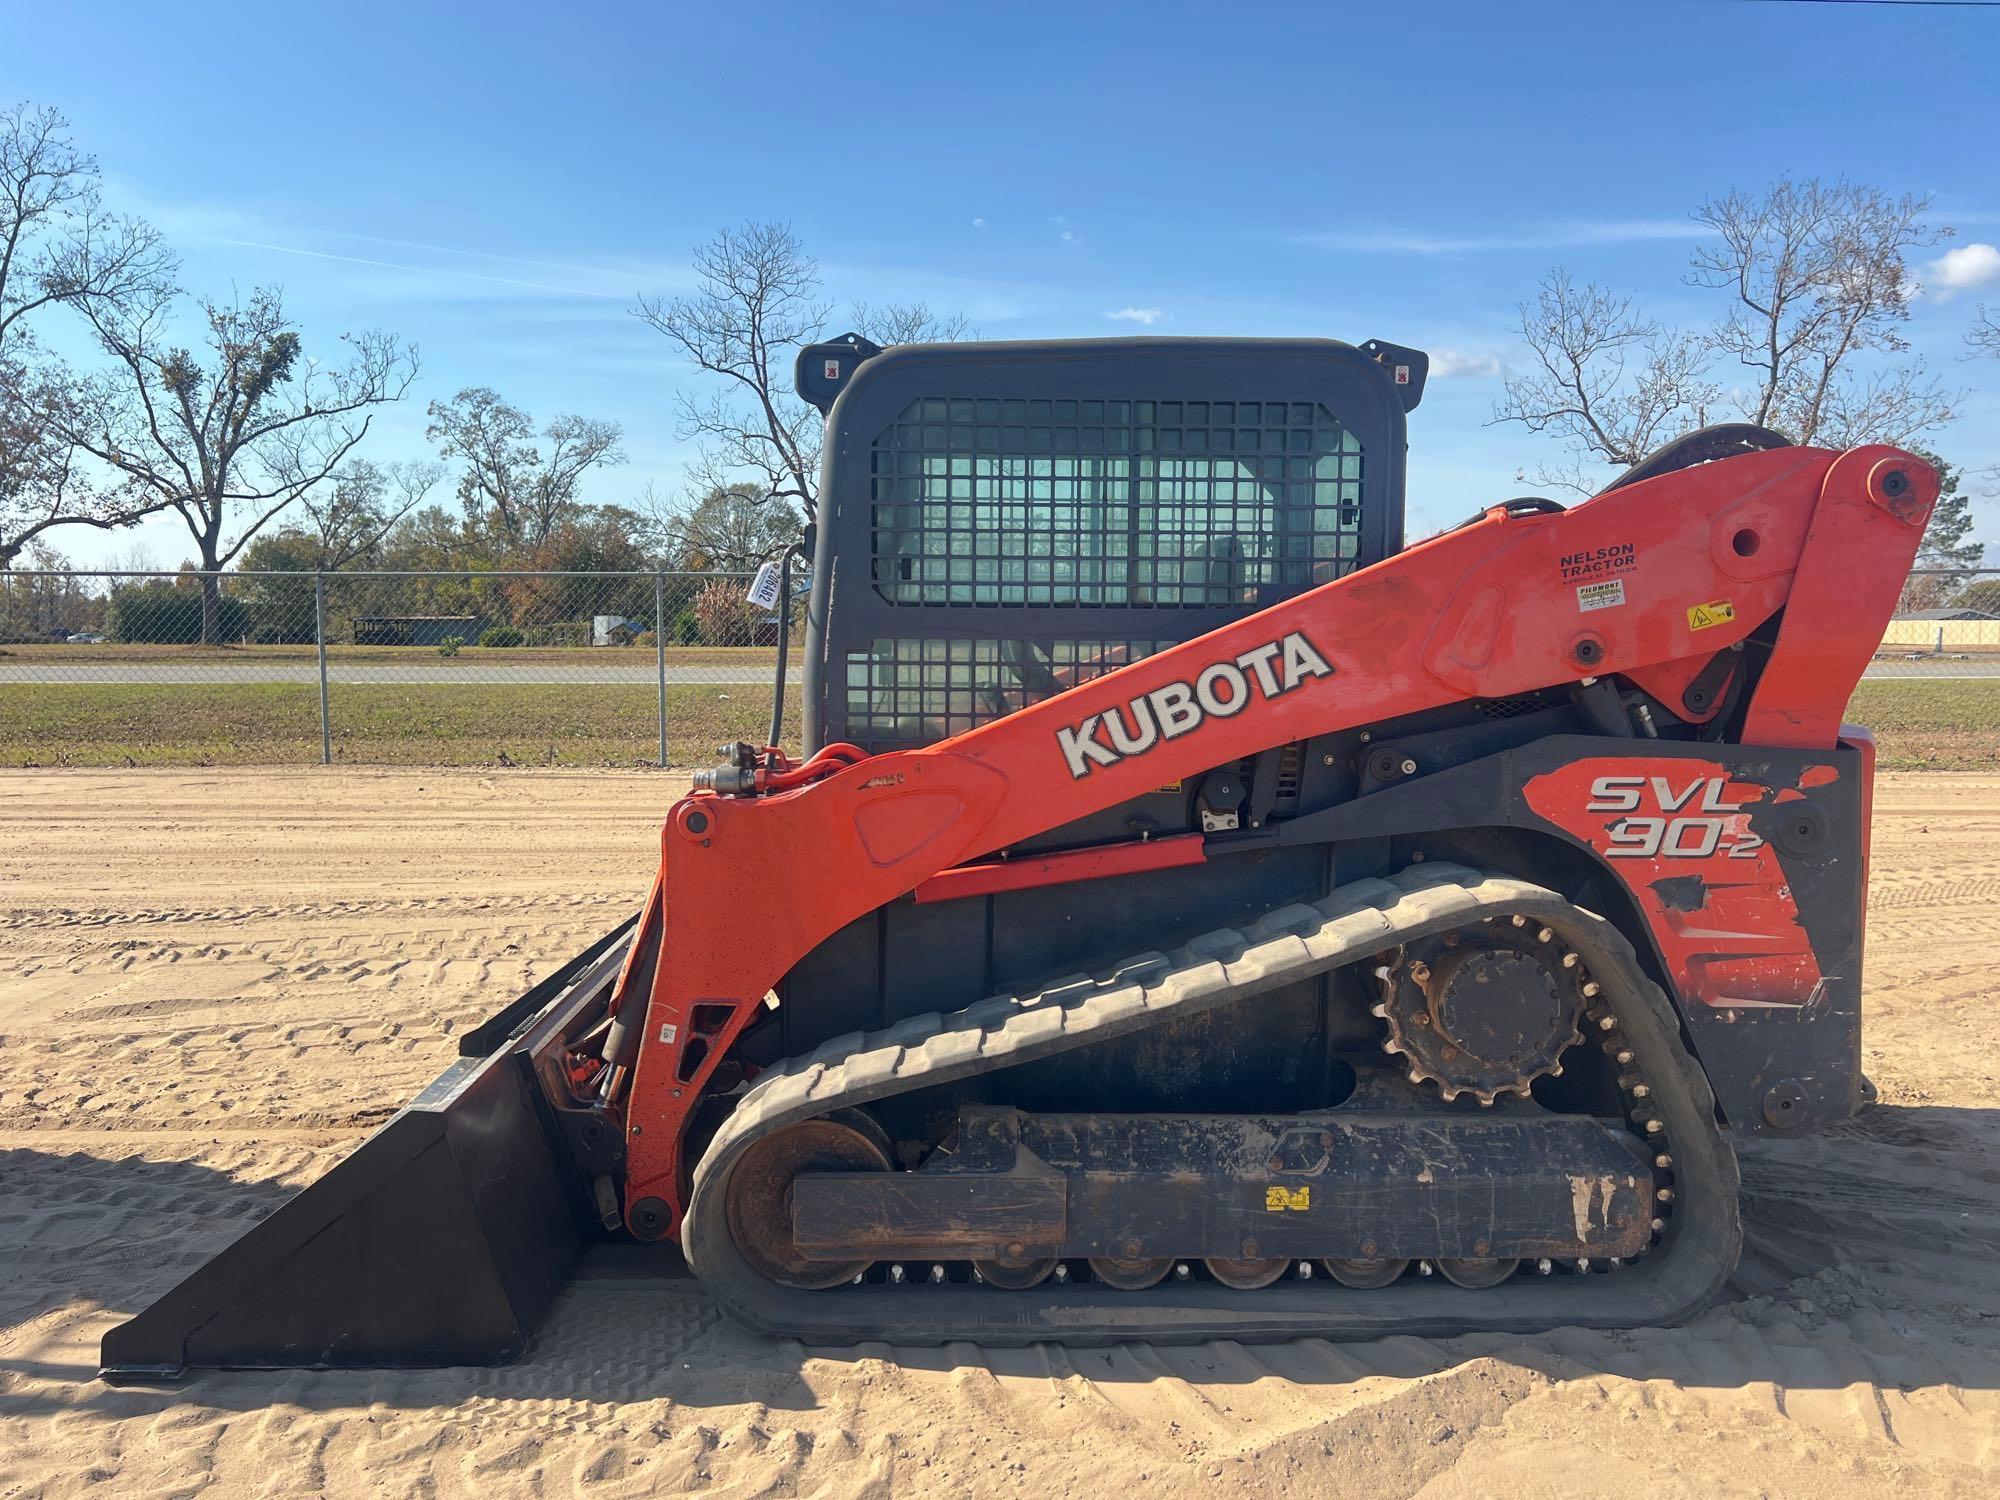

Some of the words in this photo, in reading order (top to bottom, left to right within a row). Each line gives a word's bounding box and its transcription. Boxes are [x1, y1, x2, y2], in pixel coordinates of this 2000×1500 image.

[1560, 543, 1634, 567] NELSON
[1560, 555, 1635, 578] TRACTOR
[759, 569, 781, 602] 206482
[1580, 581, 1620, 595] PIEDMONT
[1056, 631, 1333, 779] KUBOTA
[1585, 776, 1743, 814] SVL
[1603, 816, 1764, 859] 90-2
